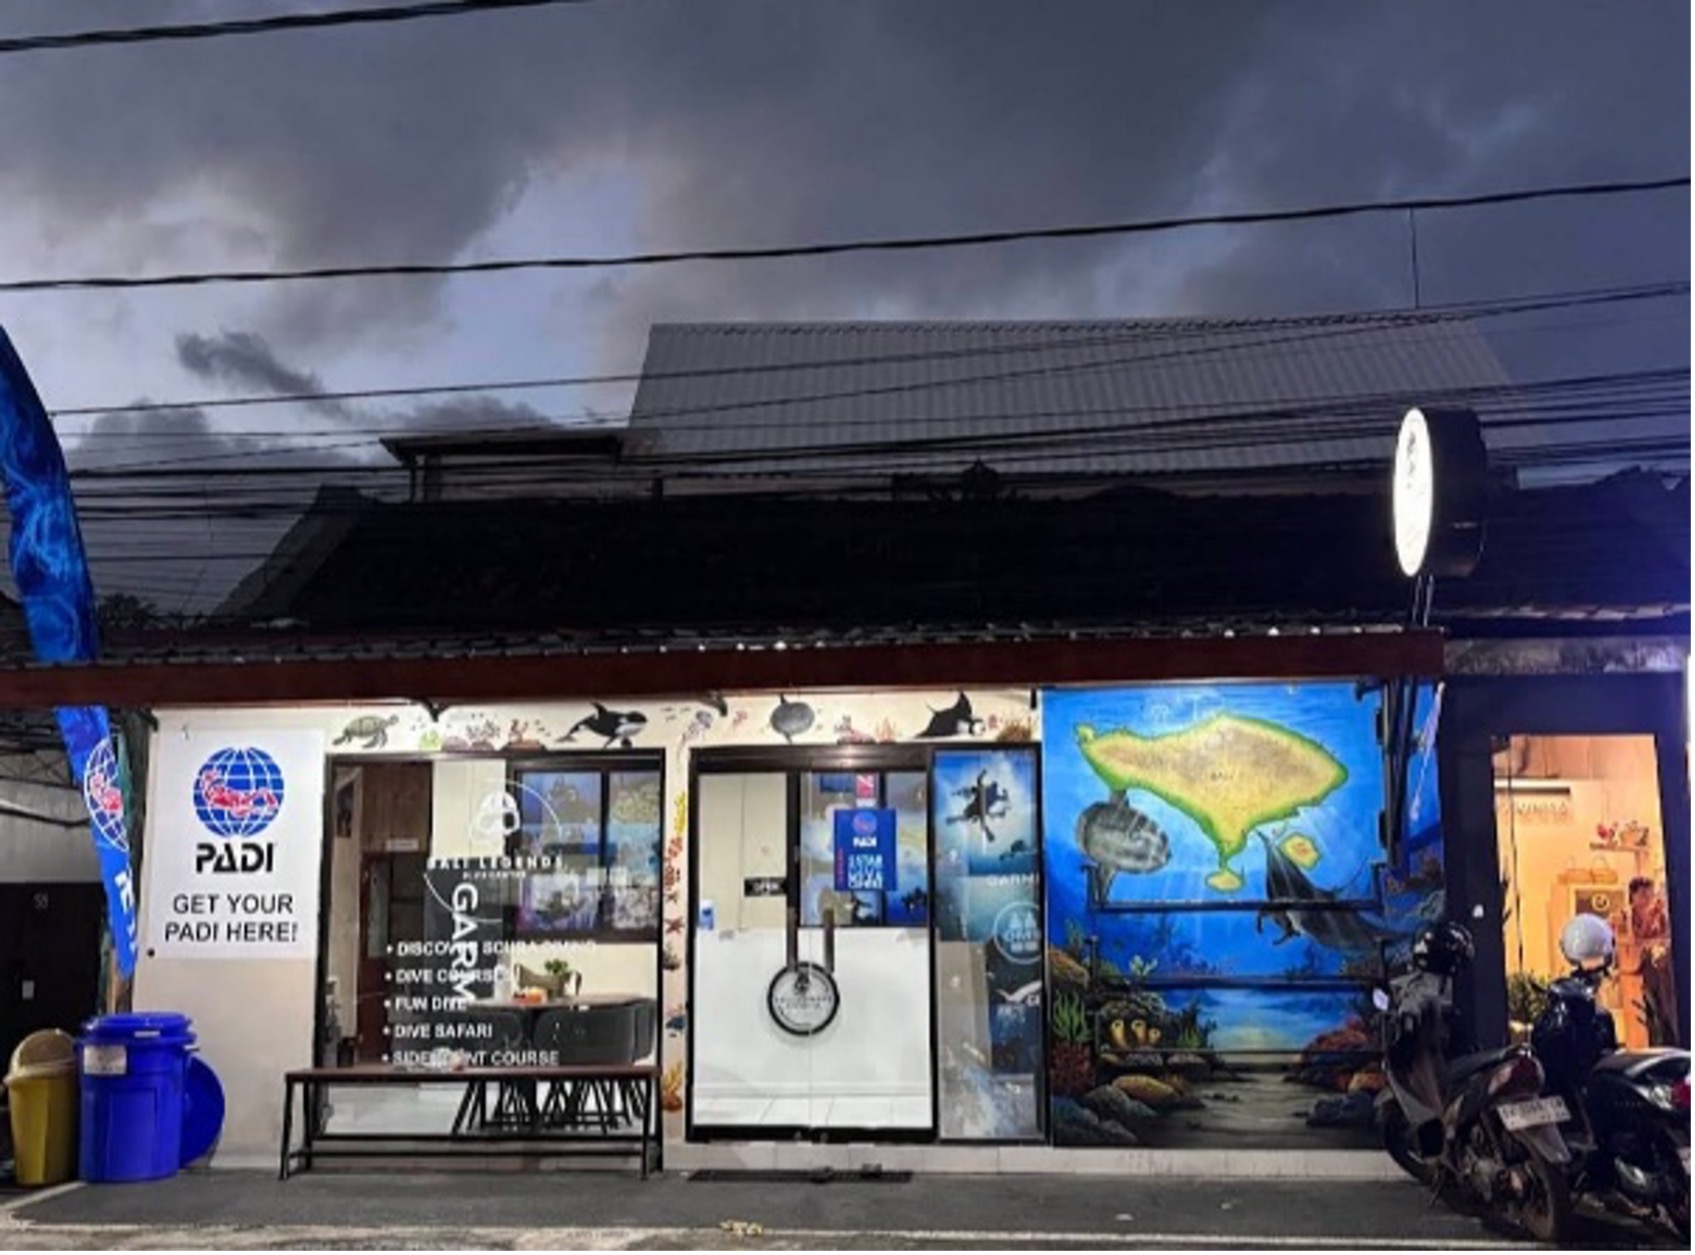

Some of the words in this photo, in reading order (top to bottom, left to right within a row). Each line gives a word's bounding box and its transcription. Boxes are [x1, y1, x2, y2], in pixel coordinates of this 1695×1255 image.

[196, 842, 274, 873] PADI
[426, 857, 470, 870] BALI
[479, 856, 563, 869] LEGENDS
[173, 893, 220, 914] GET
[227, 893, 293, 914] YOUR
[165, 921, 219, 942] PADI
[226, 921, 298, 942] HERE!
[397, 941, 478, 956] DISCOV
[396, 968, 433, 983] DIVE
[395, 997, 428, 1012] FUN
[395, 1023, 431, 1039] DIVE
[434, 1023, 493, 1039] SAFARI
[393, 1051, 487, 1067] SIDEONT
[491, 1051, 559, 1067] COURSE
